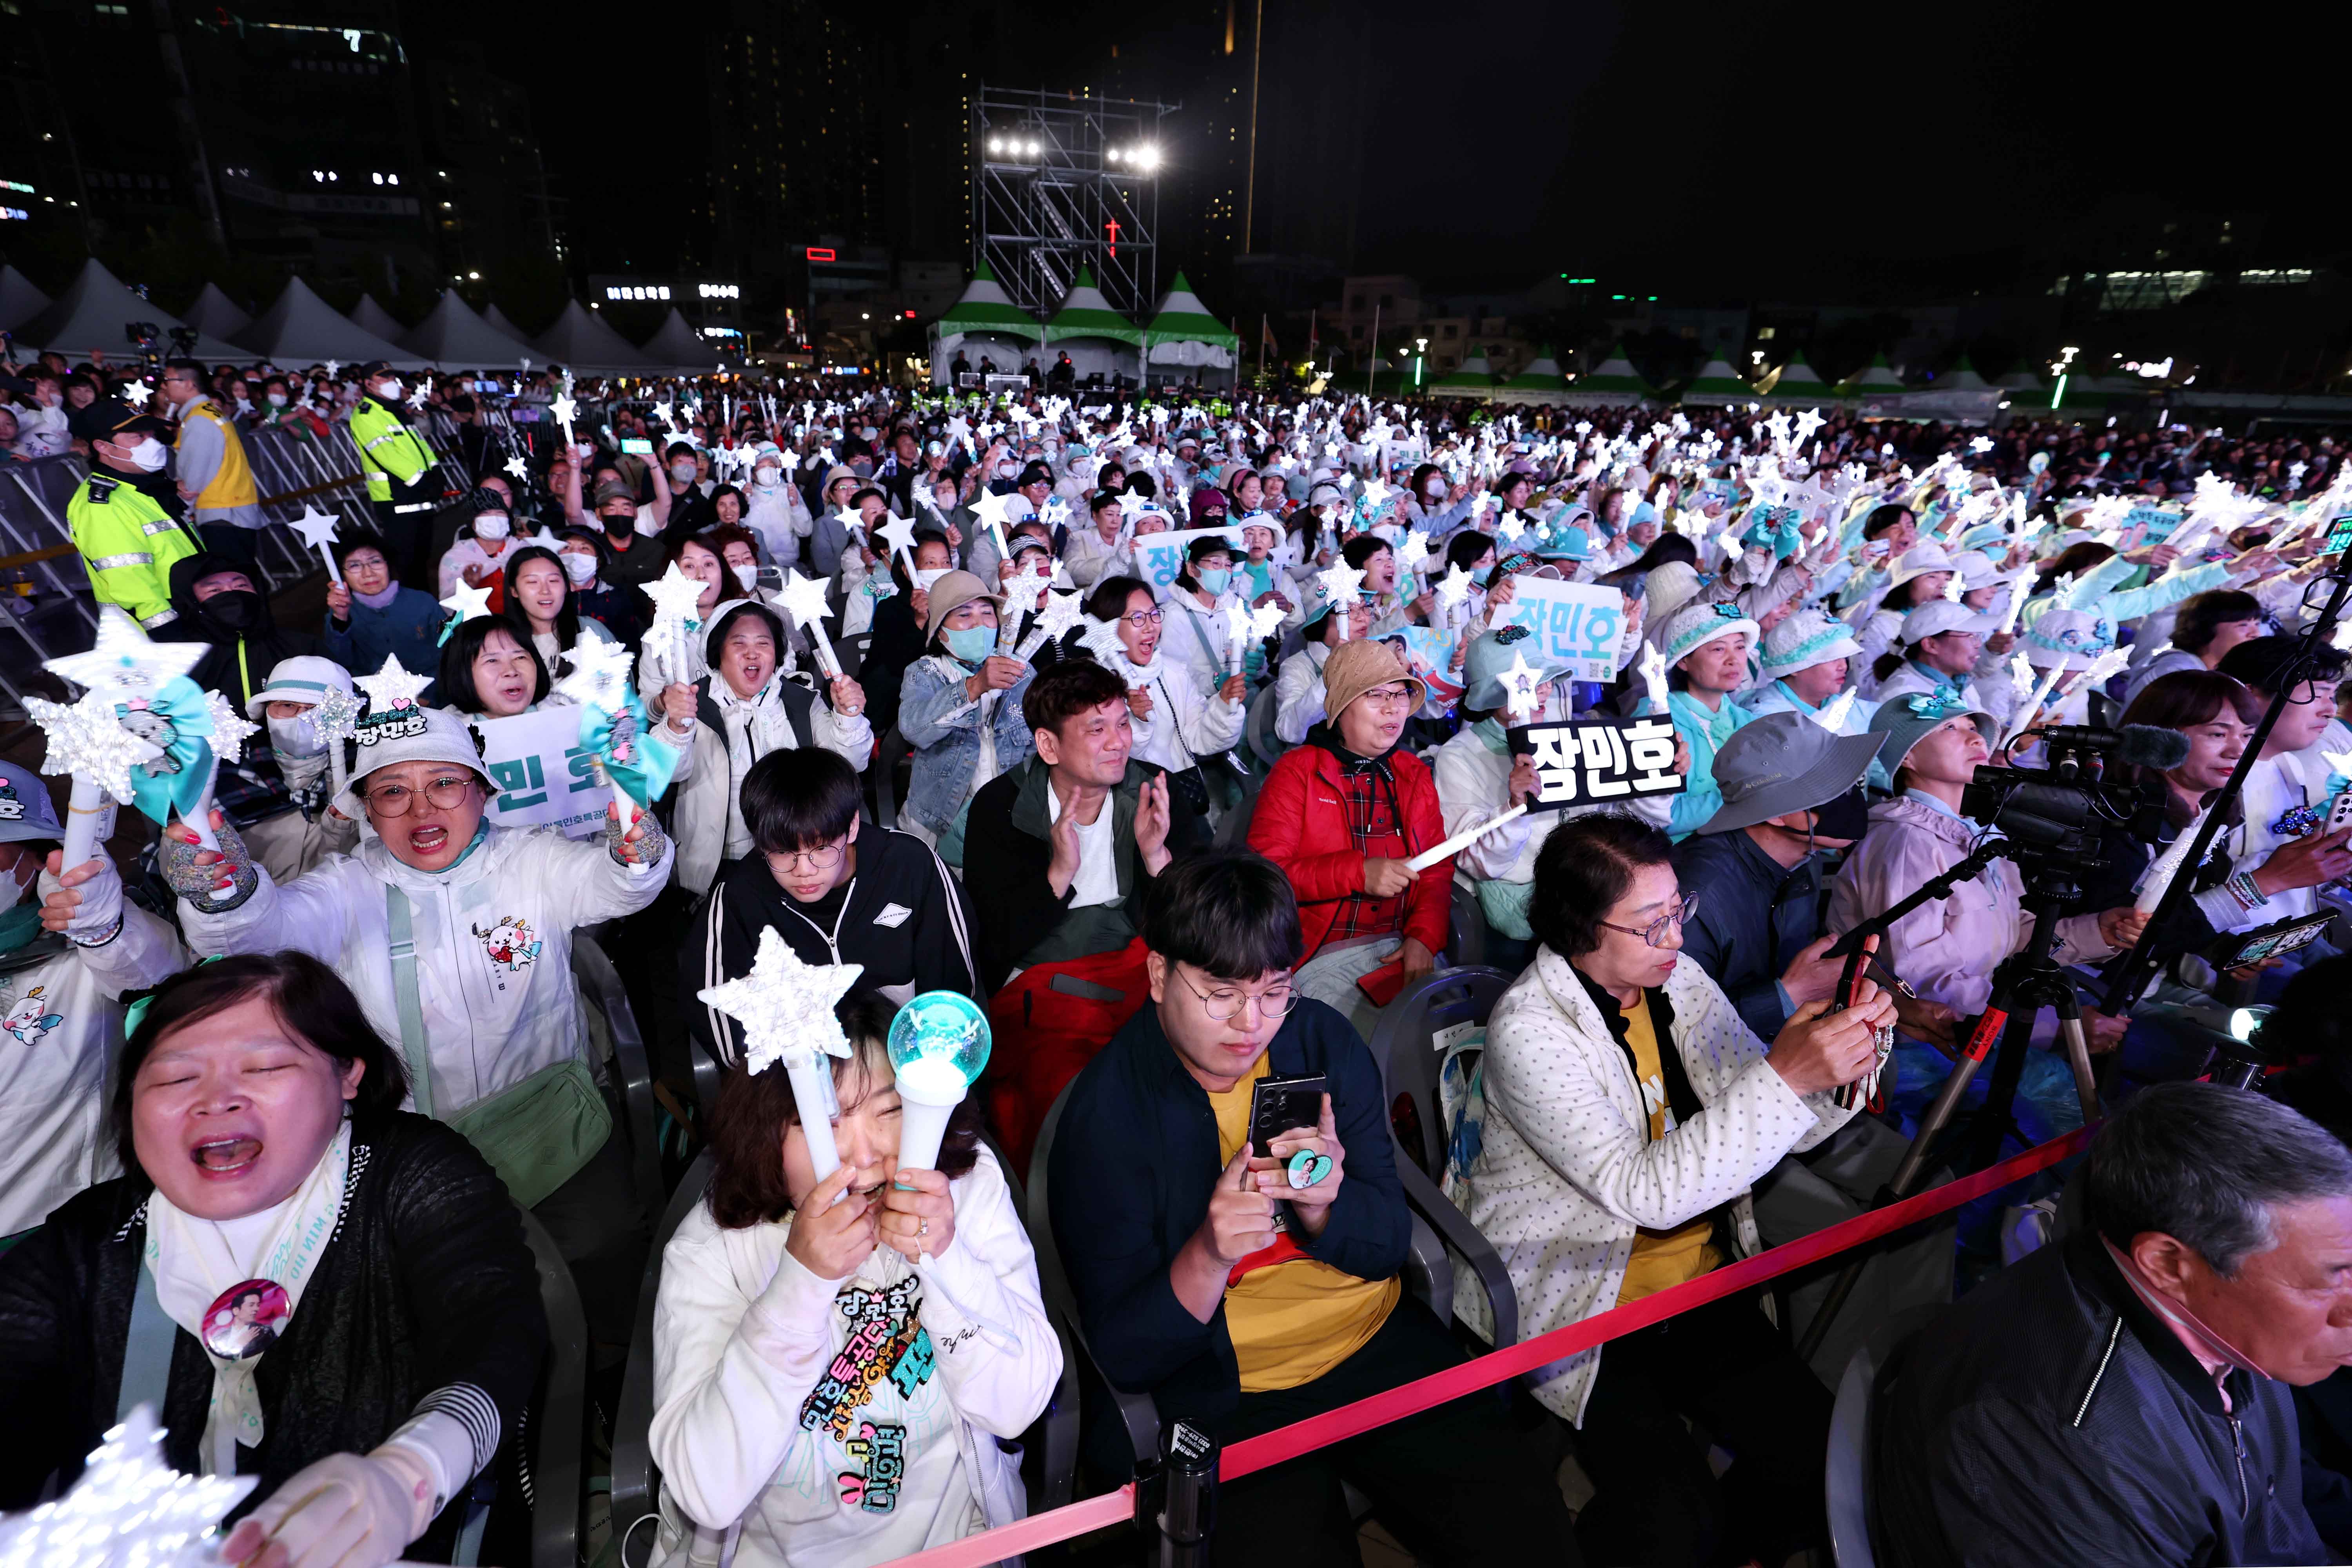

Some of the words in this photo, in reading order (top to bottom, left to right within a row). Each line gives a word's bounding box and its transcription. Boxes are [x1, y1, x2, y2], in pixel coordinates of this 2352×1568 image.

[1509, 597, 1621, 659] 장민호
[353, 716, 426, 746] 장민호
[1527, 719, 1681, 803] 장민호
[1751, 773, 1782, 787] Columbia
